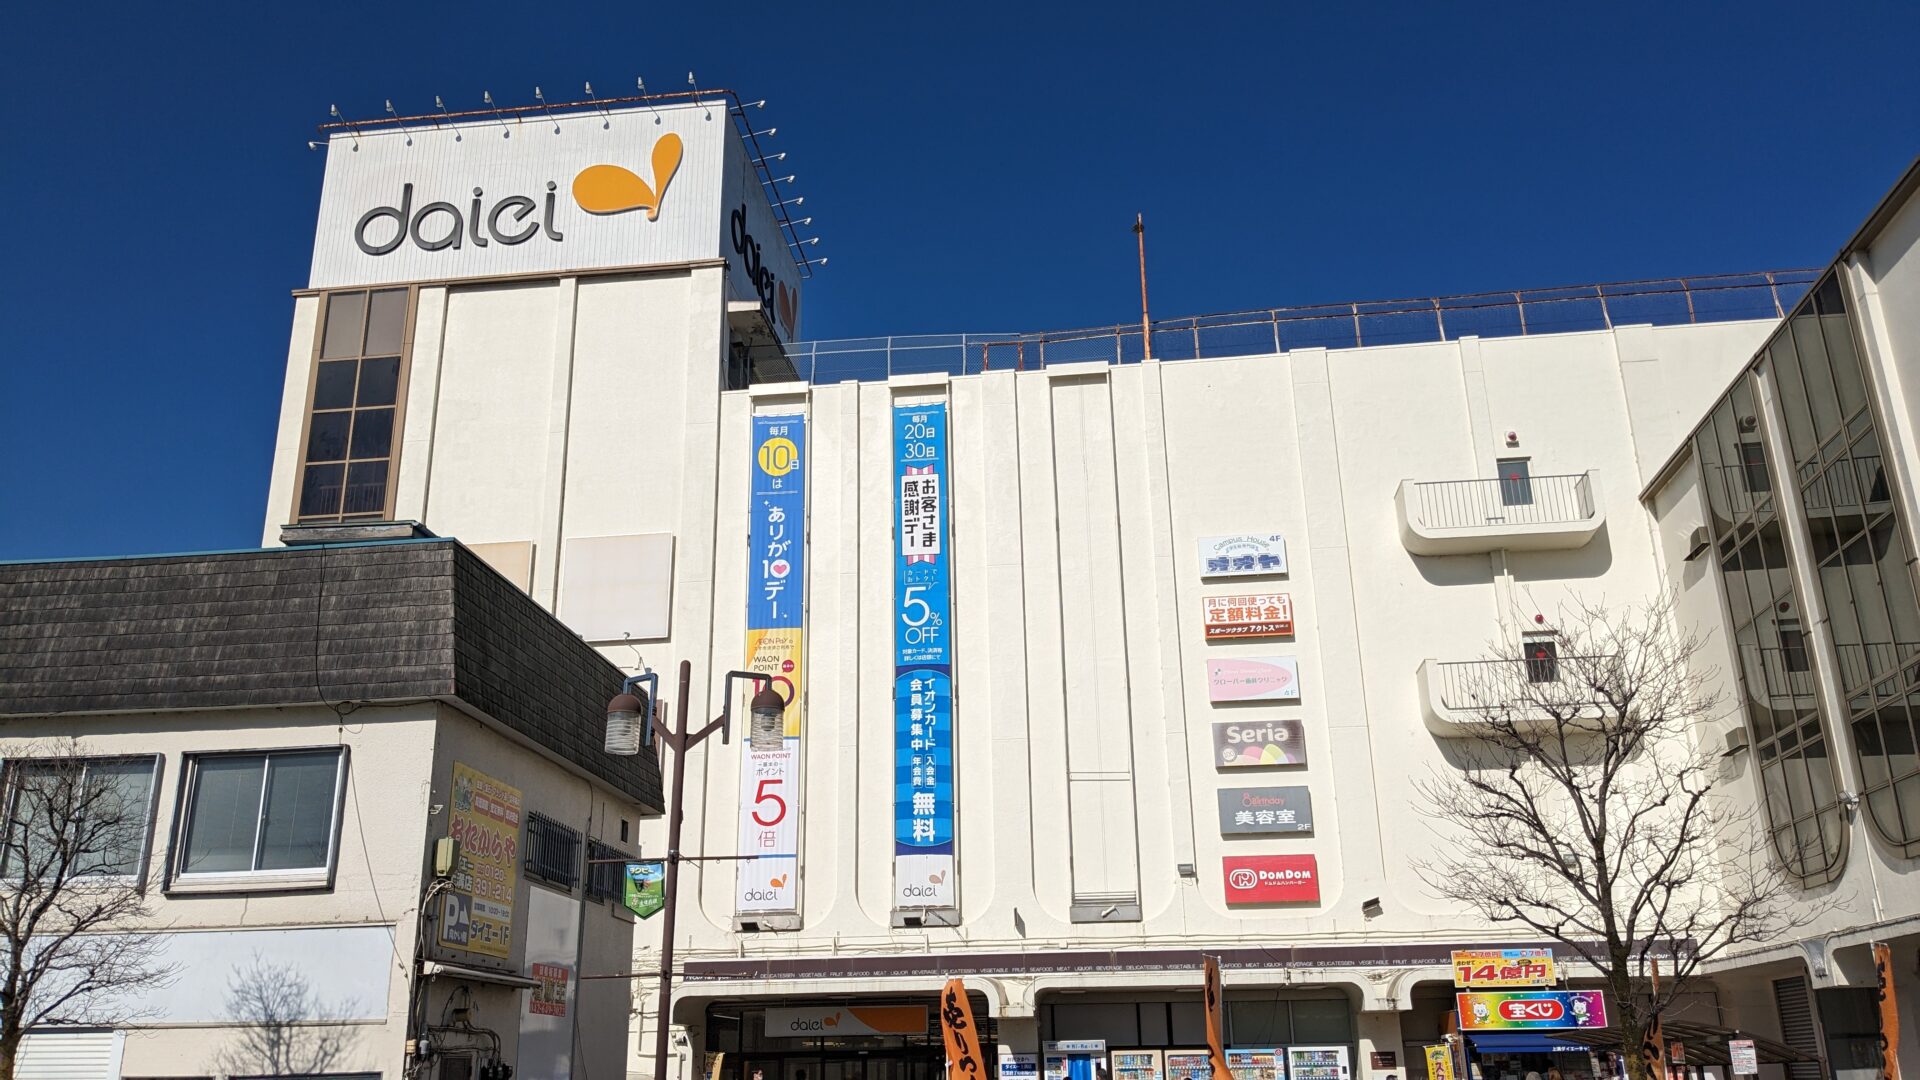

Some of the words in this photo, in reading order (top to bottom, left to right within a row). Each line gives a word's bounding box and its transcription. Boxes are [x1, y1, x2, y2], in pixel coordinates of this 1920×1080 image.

[354, 181, 564, 256] daiei
[730, 203, 776, 324] daiei
[770, 426, 788, 436] 毎月
[904, 424, 935, 440] 20日
[904, 442, 935, 458] 30日
[772, 478, 782, 489] は
[904, 481, 920, 547] 感謝デー
[921, 479, 937, 547] お客さま
[902, 586, 942, 626] 5%
[1208, 596, 1286, 607] 月に何回使っても
[1209, 604, 1288, 622] 定額料金!
[905, 627, 939, 644] OFF
[910, 679, 923, 751] 会員募集中
[924, 678, 936, 750] イオンカード
[1226, 723, 1289, 743] Seria
[913, 756, 922, 786] 年会費
[926, 757, 935, 786] 入会金
[752, 779, 786, 826] 5
[913, 792, 935, 842] 無料
[1235, 809, 1296, 825] 美容室
[450, 812, 516, 867] おたからや
[758, 831, 776, 847] 倍
[744, 888, 778, 901] daiei
[903, 884, 937, 897] daiei
[443, 894, 459, 940] P
[1458, 964, 1546, 982] 14億円
[1509, 1003, 1553, 1017] 宝くじ
[790, 1018, 824, 1031] daiei
